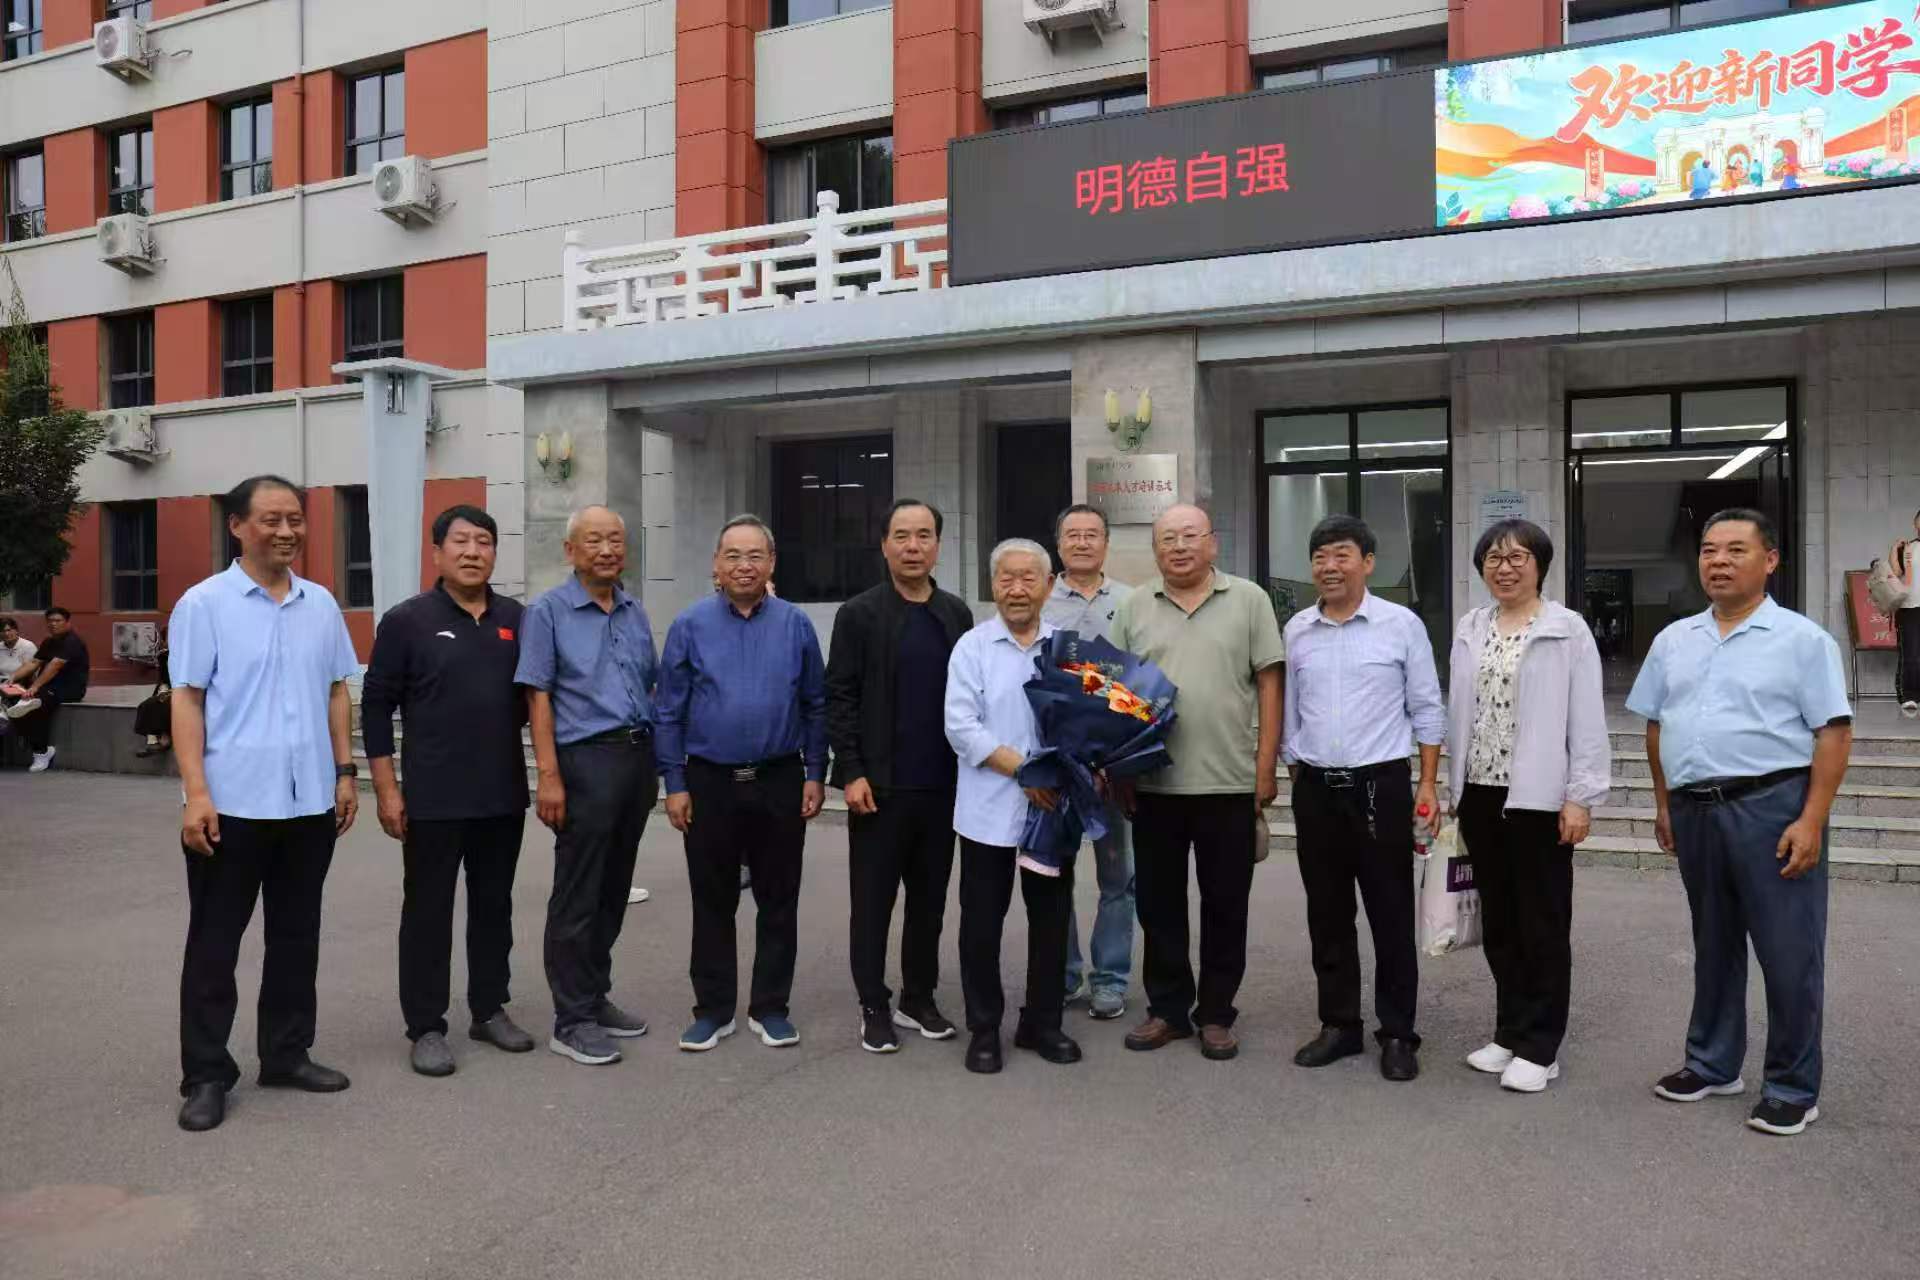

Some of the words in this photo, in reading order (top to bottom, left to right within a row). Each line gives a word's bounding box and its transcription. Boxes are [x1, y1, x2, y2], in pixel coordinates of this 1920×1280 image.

[1557, 8, 1920, 142] 欢迎新同学
[1075, 143, 1290, 216] 明德自强
